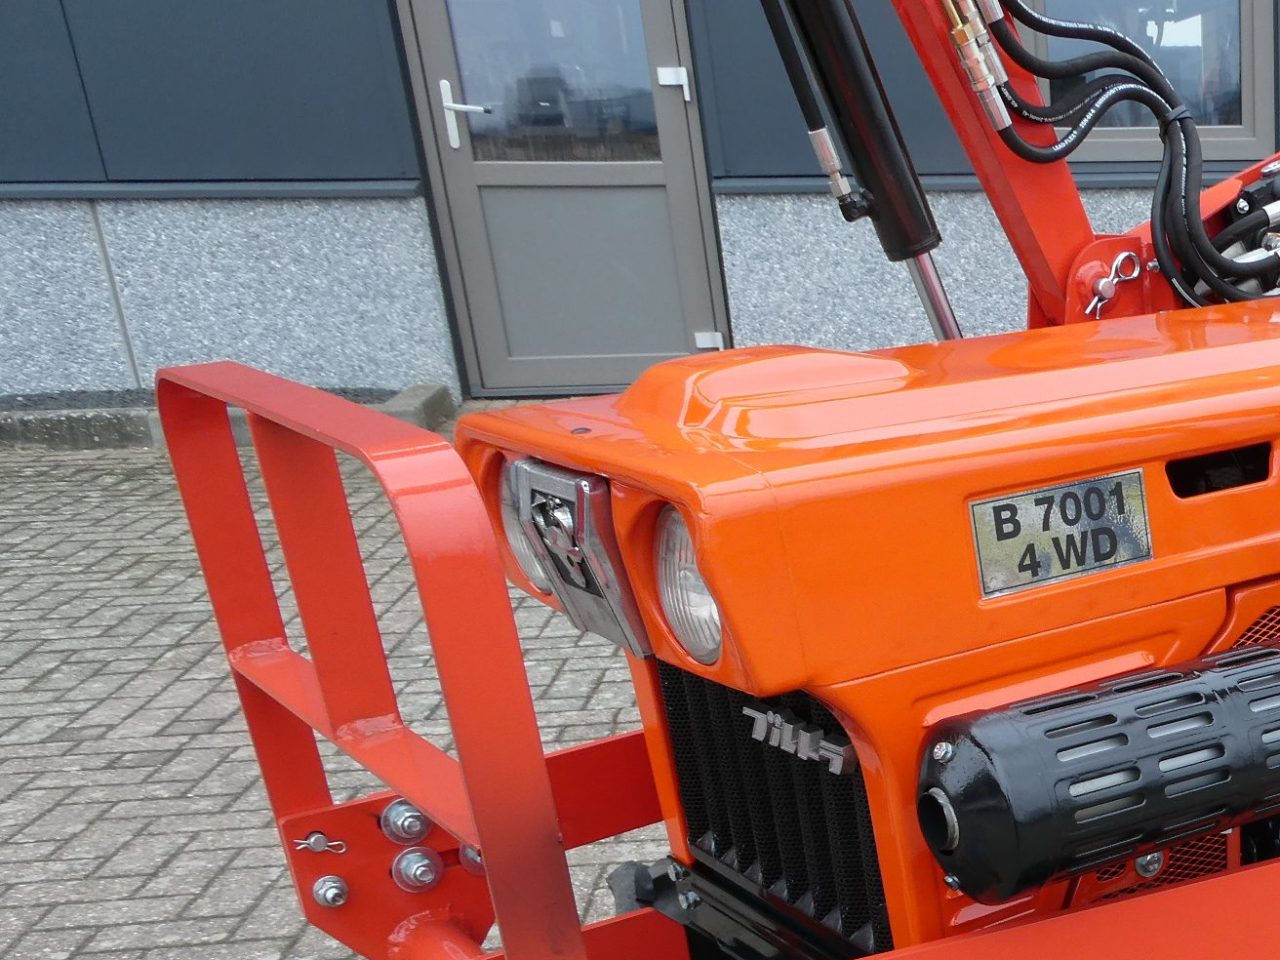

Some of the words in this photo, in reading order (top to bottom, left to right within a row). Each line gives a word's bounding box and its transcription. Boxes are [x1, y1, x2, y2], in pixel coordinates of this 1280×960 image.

[993, 503, 1021, 541] B
[1035, 482, 1125, 532] 7001
[1018, 543, 1042, 577] 4
[1052, 527, 1118, 570] WD
